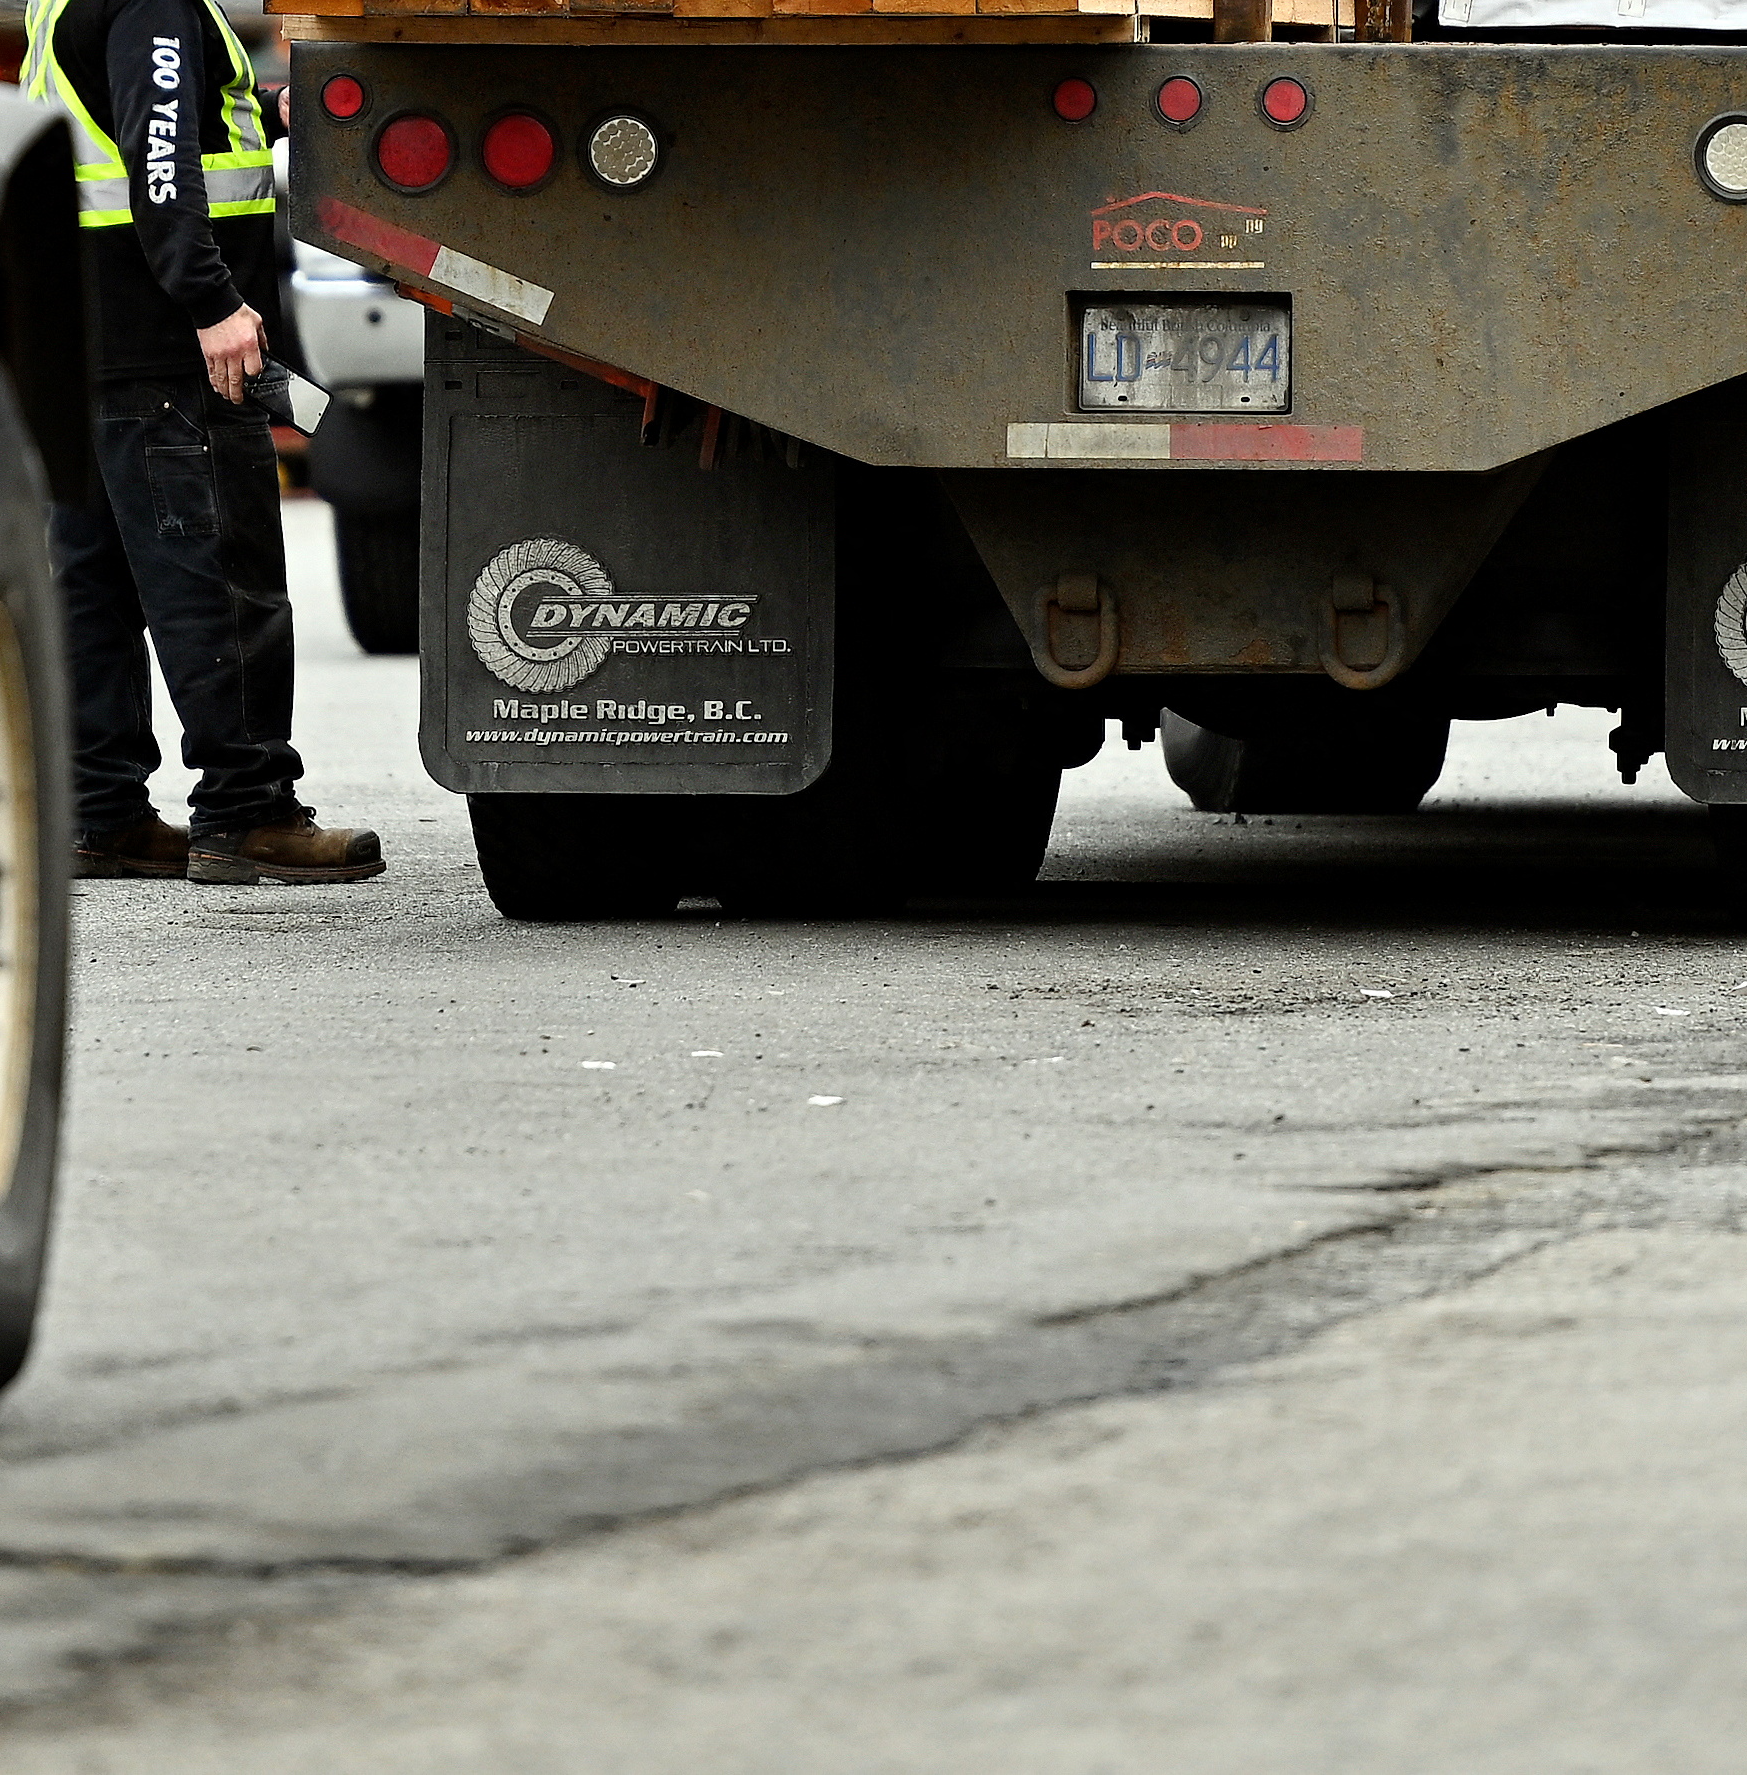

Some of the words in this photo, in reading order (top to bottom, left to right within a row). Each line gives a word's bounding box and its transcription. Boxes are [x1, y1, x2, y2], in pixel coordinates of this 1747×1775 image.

[151, 36, 182, 90] 100
[147, 99, 180, 205] YEARS
[1092, 219, 1203, 252] POCO
[530, 602, 752, 628] DYNAMIC
[613, 639, 745, 653] POWERTRAIN
[748, 639, 792, 653] LTD.
[493, 699, 588, 724] Maple
[596, 699, 695, 725] Ridge,
[704, 700, 762, 721] B.C.
[465, 728, 789, 746] www.dynamicpowertrain.com
